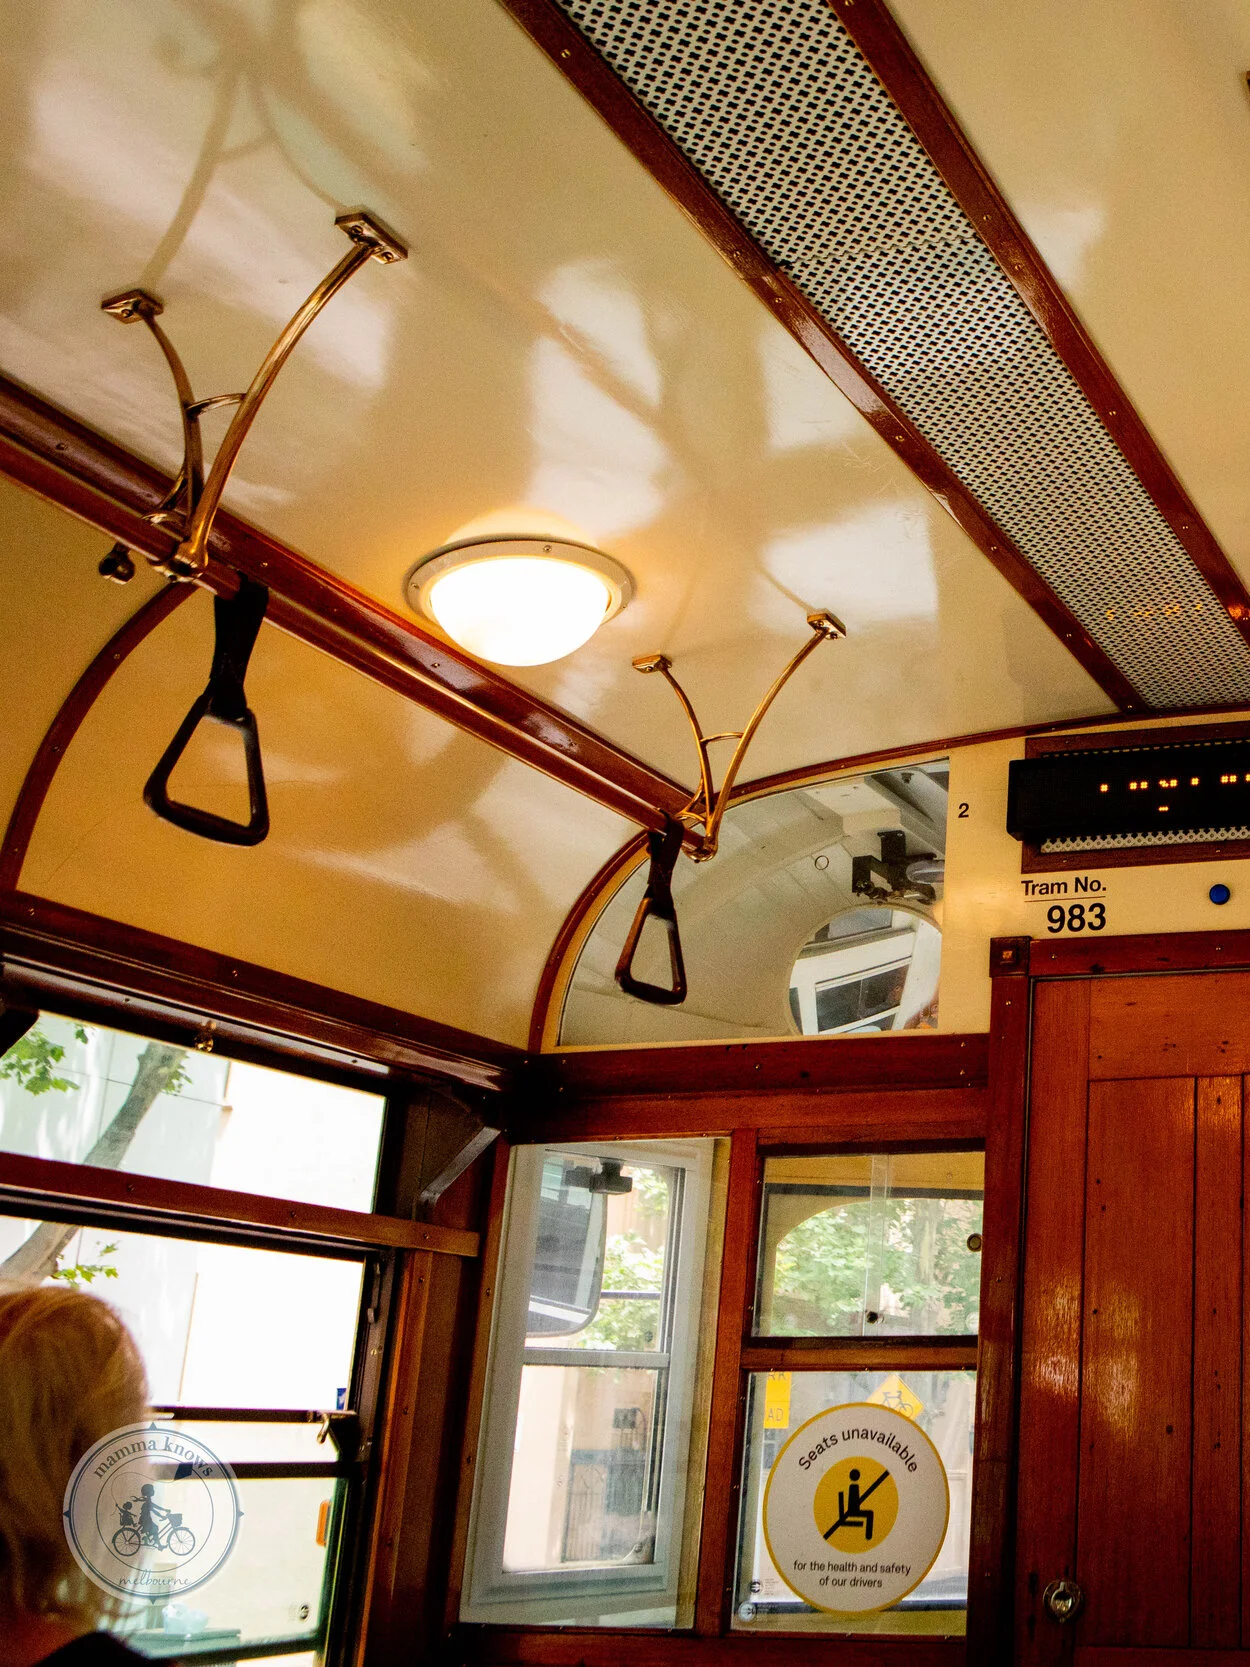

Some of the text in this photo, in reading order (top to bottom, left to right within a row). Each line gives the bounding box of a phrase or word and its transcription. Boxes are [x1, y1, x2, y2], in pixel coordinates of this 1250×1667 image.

[957, 803, 970, 818] 2
[1021, 876, 1107, 896] Tram No.
[1047, 902, 1106, 933] 983
[798, 1427, 918, 1473] Seats unavailable
[793, 1560, 911, 1576] for the health and safety
[819, 1577, 883, 1588] of our drivers
